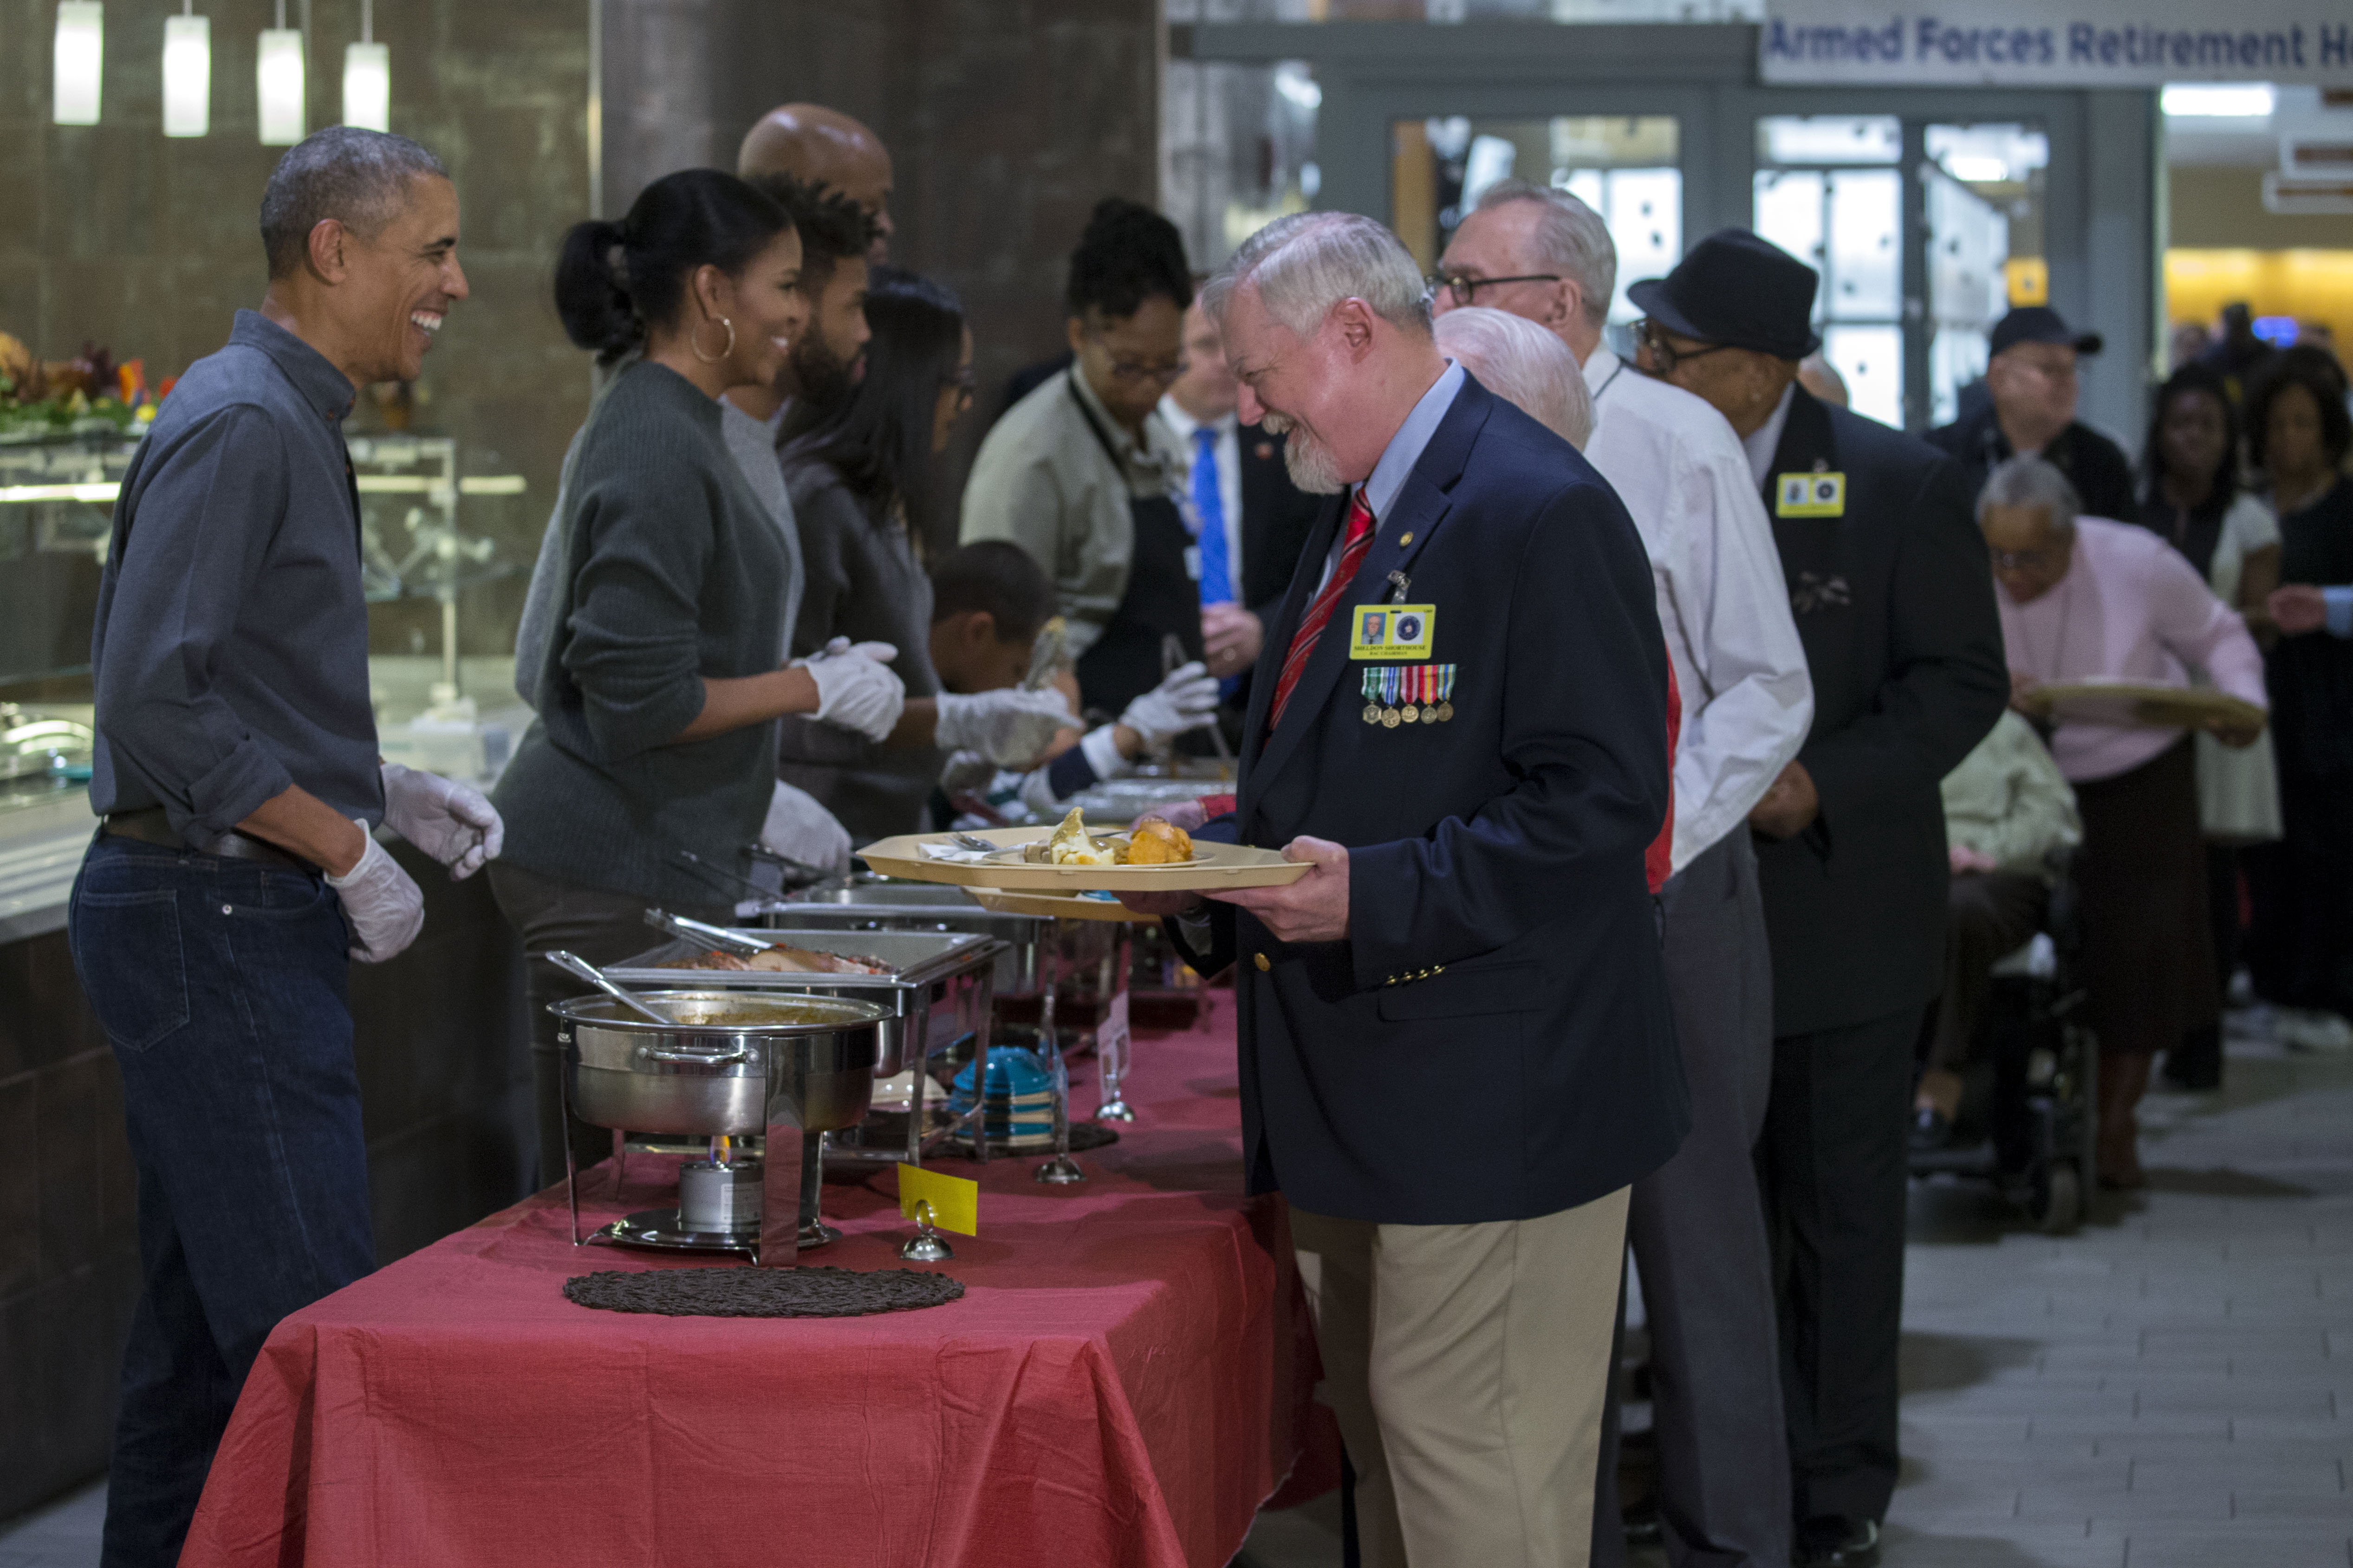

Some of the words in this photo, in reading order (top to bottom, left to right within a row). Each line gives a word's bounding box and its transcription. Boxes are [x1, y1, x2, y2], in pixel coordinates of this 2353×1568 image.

[1766, 17, 1904, 62] Armed
[1915, 18, 2054, 64] Forces
[2068, 21, 2304, 66] Retirement
[2320, 24, 2353, 66] H
